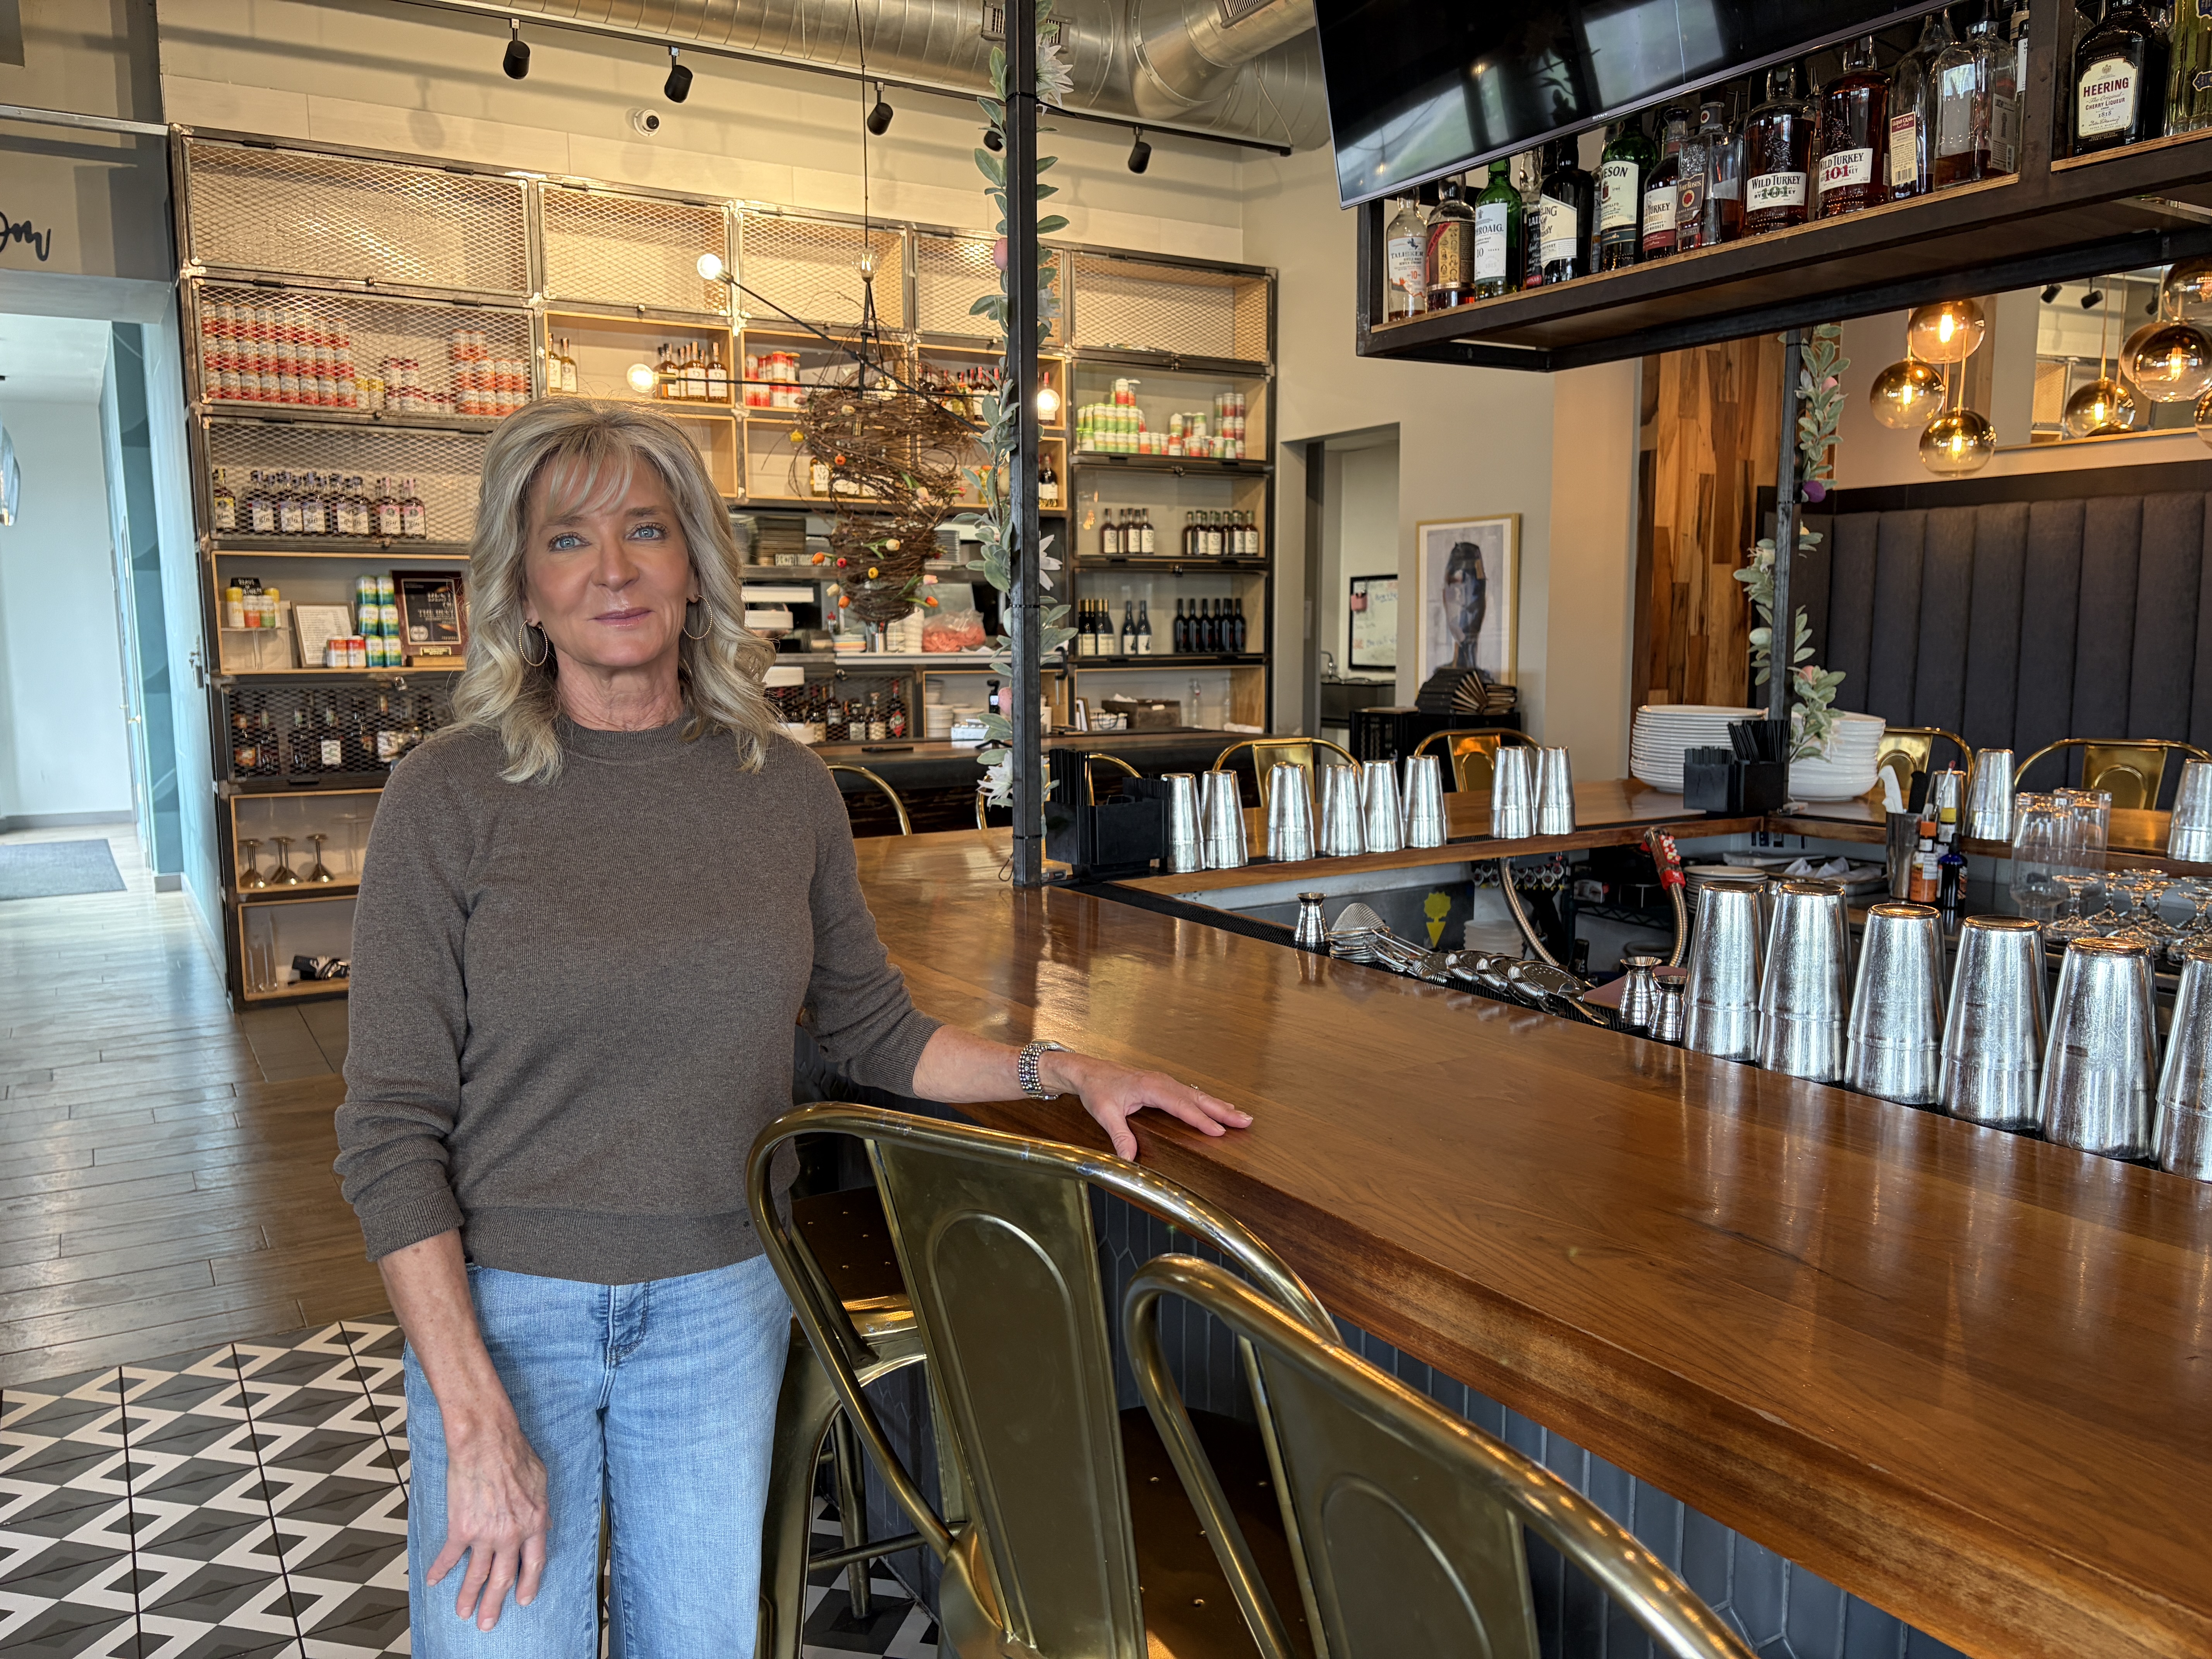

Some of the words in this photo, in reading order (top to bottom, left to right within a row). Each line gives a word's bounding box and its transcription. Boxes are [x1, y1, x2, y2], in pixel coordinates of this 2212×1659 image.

[2083, 77, 2129, 97] HEERING
[2106, 98, 2125, 106] LIQUEUR
[1832, 153, 1864, 166] TURKEY
[1602, 167, 1628, 178] ESON
[1825, 165, 1849, 182] 101
[1752, 178, 1771, 190] WILD
[1771, 175, 1801, 185] TURKEY
[1761, 185, 1788, 200] 101
[1648, 203, 1670, 215] TURKEY
[1477, 248, 1484, 258] 10
[1411, 271, 1417, 279] 10
